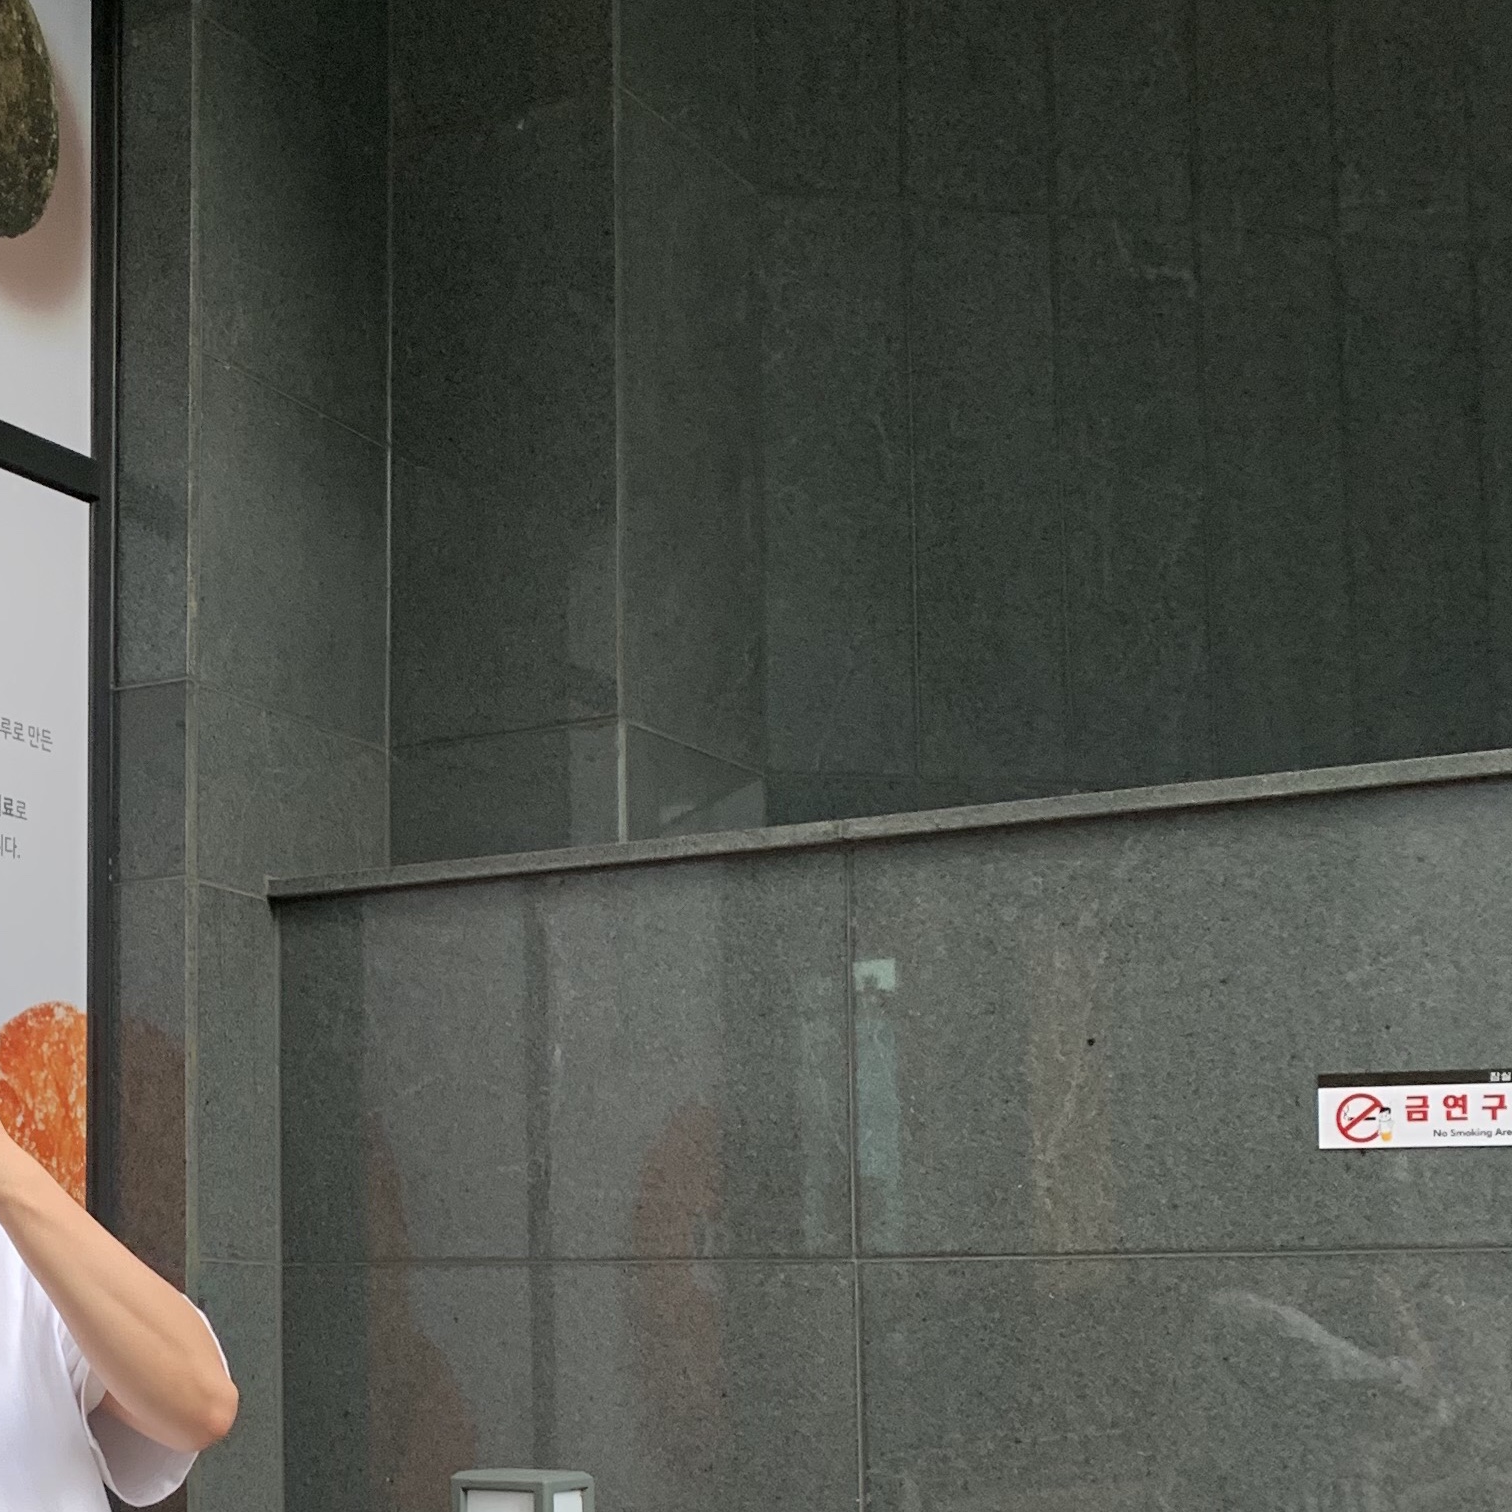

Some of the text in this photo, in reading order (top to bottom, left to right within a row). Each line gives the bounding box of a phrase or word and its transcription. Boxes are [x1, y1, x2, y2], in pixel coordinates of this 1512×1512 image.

[27, 725, 54, 753] 만든
[1433, 1128, 1448, 1138] No
[1450, 1127, 1493, 1139] Smoking
